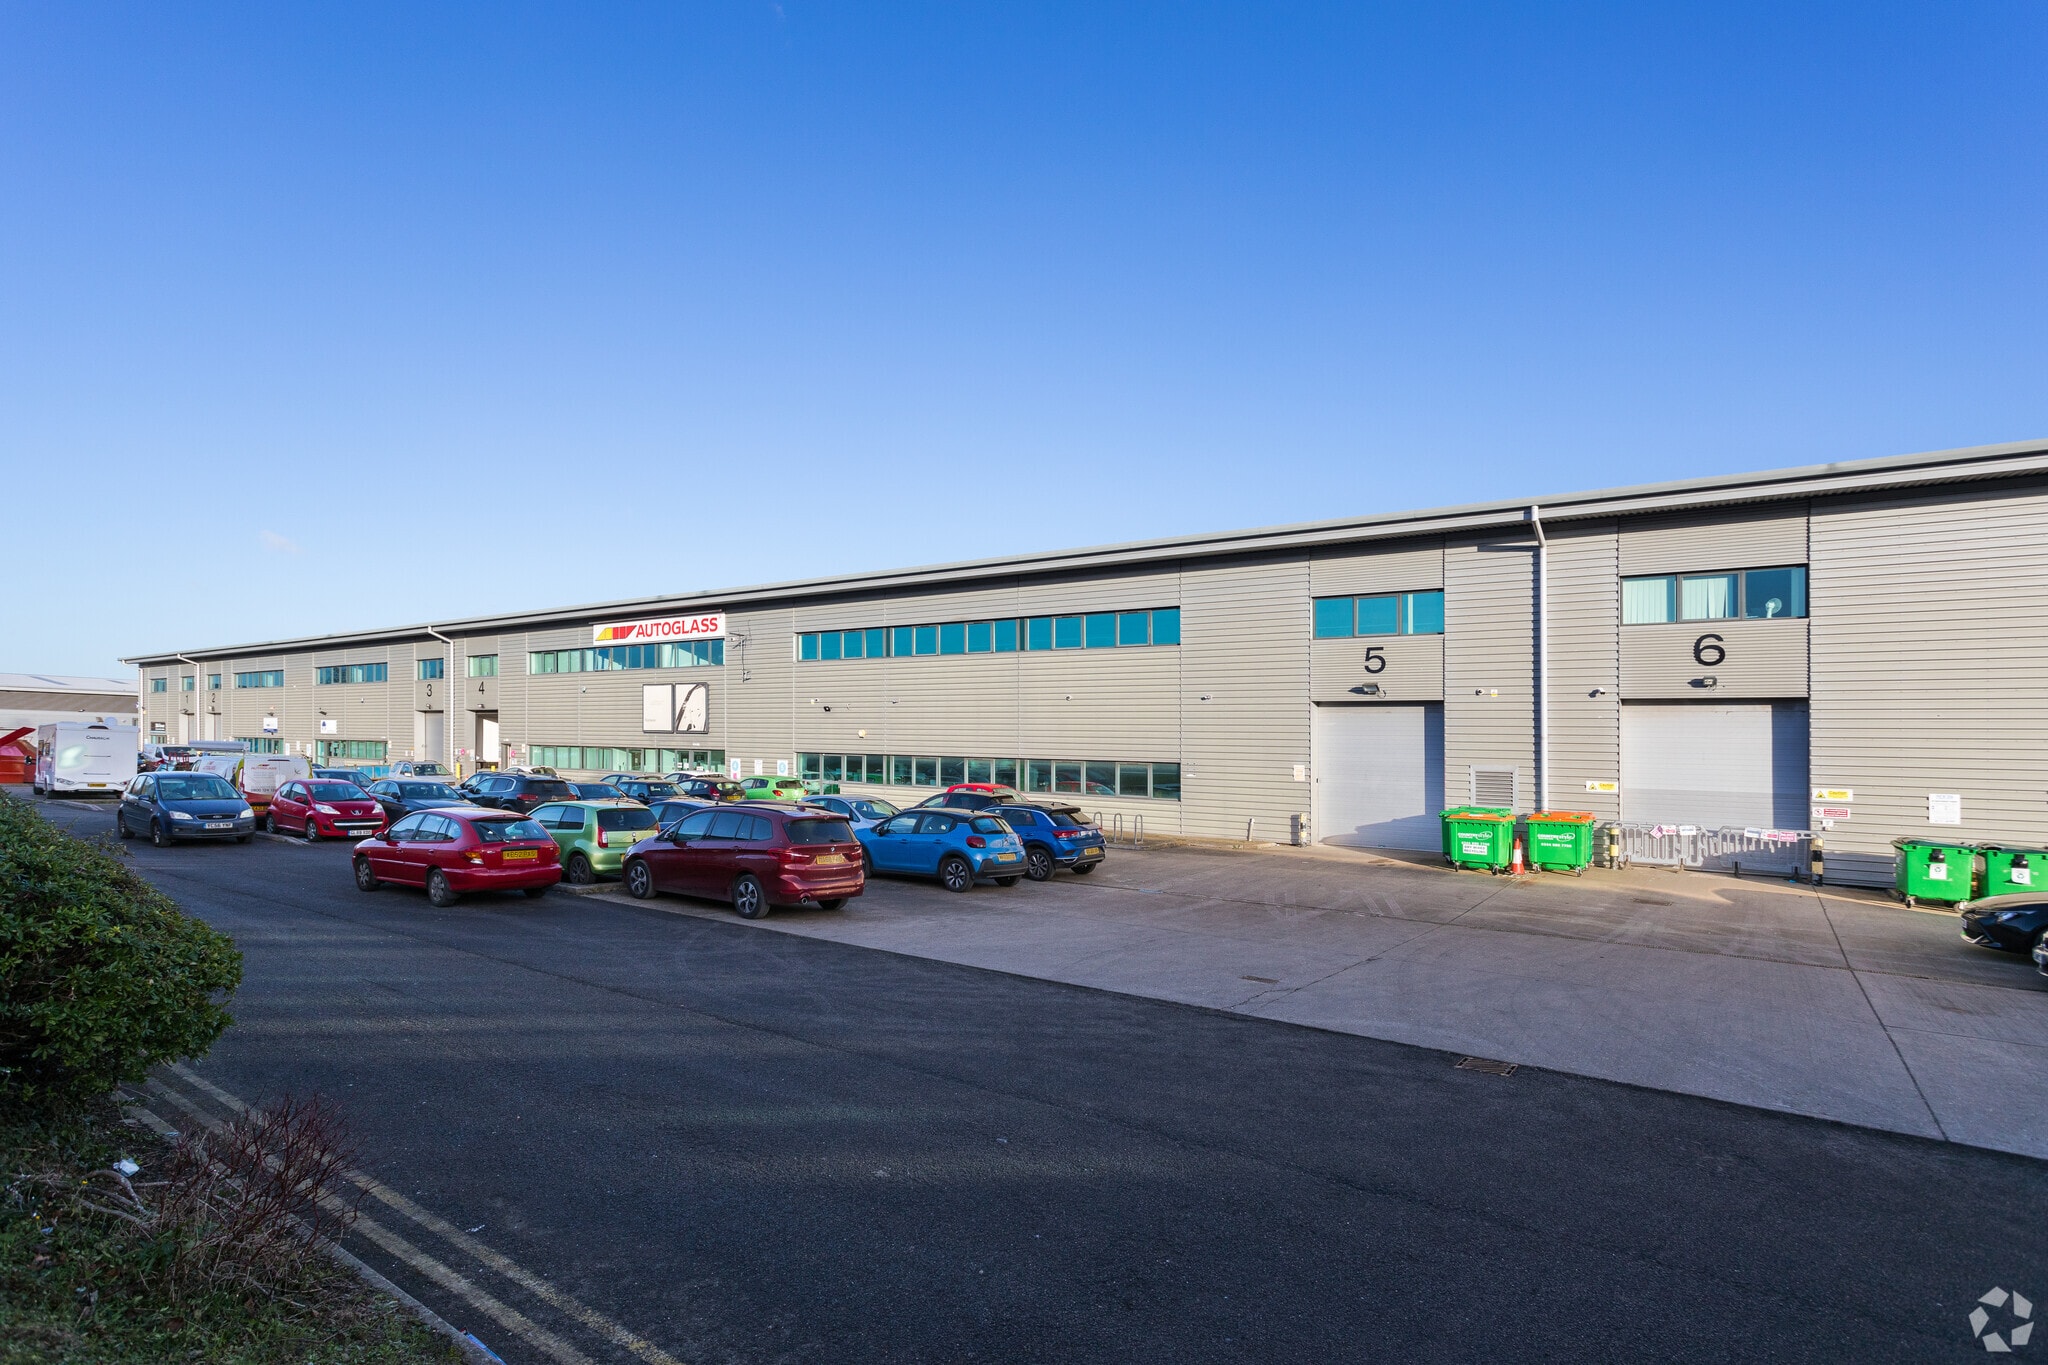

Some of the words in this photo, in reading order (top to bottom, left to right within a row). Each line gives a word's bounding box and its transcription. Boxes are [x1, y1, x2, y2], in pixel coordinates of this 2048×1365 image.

[636, 617, 718, 638] AUTOGLASS
[1693, 634, 1726, 666] 6
[1364, 646, 1387, 674] 5
[426, 683, 433, 697] 3
[478, 681, 485, 695] 4
[211, 693, 216, 703] 2
